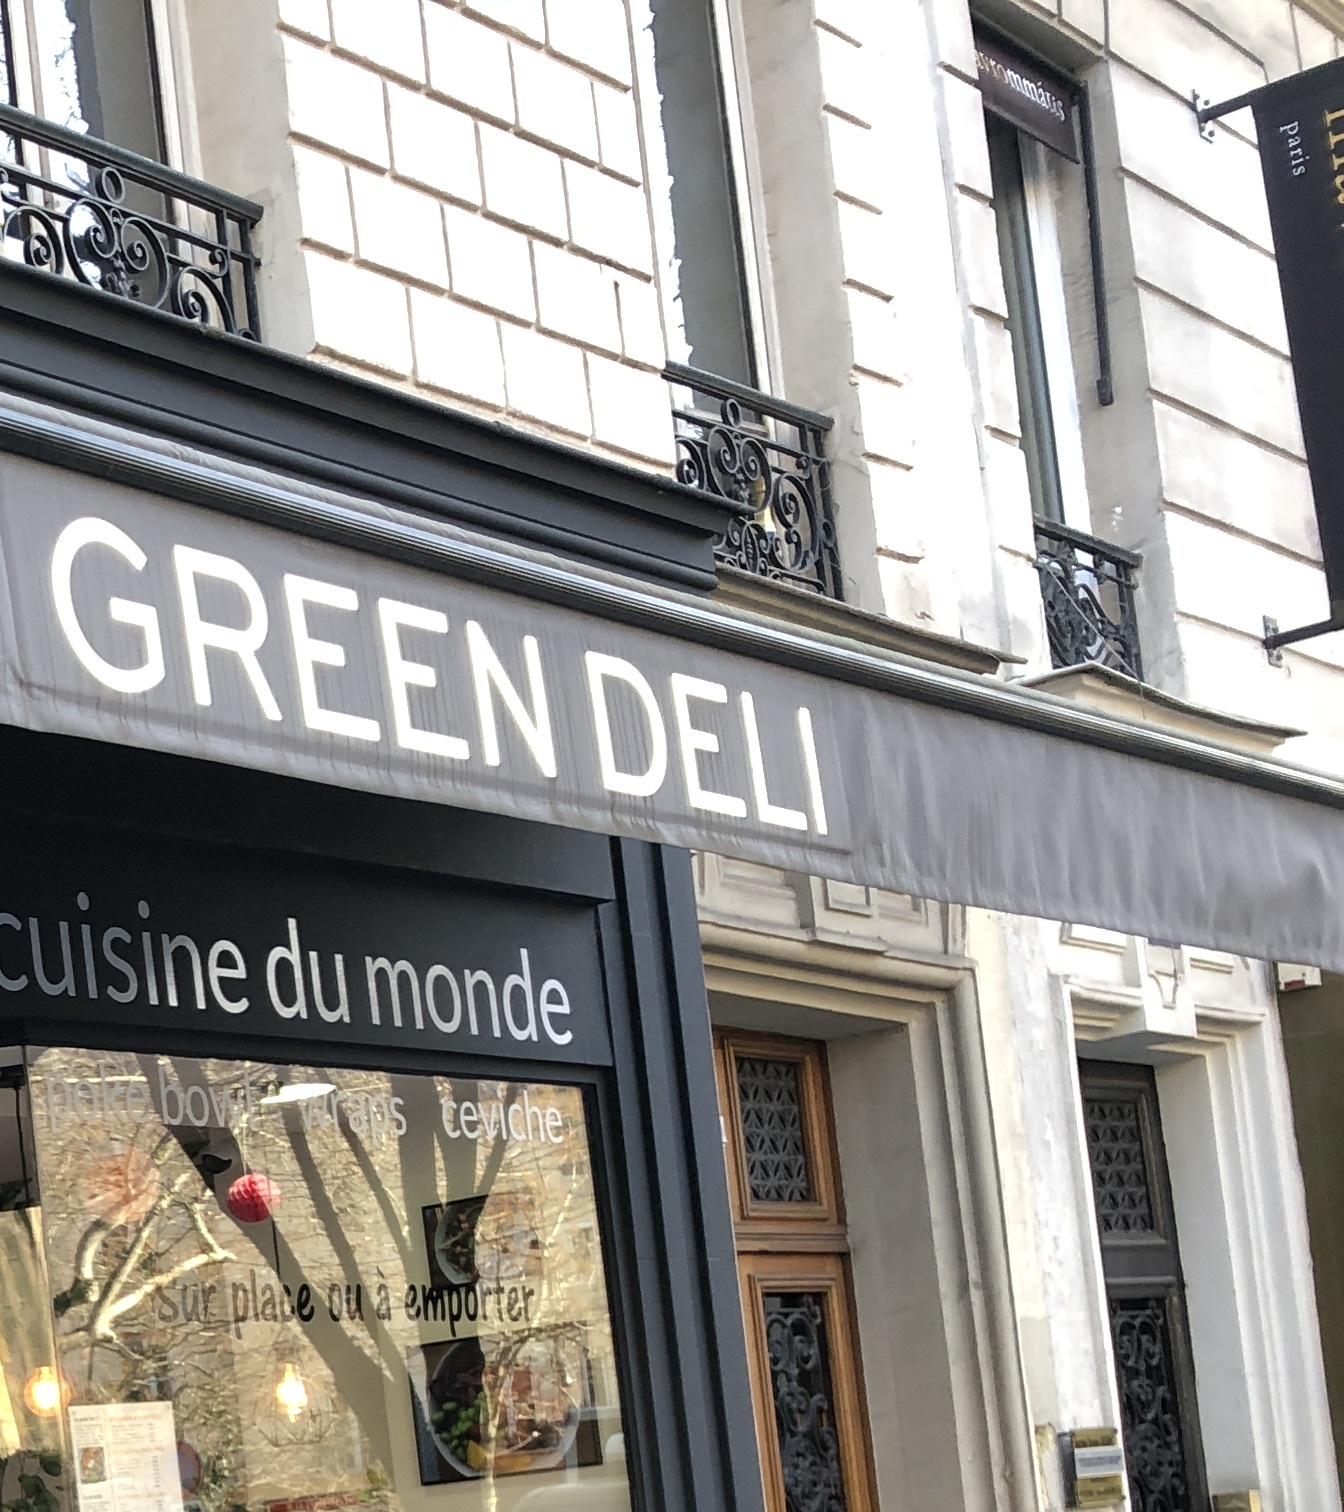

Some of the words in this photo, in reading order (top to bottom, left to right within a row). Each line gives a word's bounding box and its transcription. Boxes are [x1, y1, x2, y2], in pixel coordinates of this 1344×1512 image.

[1278, 121, 1311, 177] paris
[50, 516, 558, 778] GREEN
[584, 650, 829, 835] DELI
[266, 916, 352, 1024] du
[365, 947, 575, 1046] monde
[157, 1064, 257, 1131] bowl
[298, 1088, 408, 1149] wraps
[441, 1087, 565, 1144] ceviche
[230, 1268, 314, 1340] place
[328, 1282, 363, 1323] ou
[376, 1265, 393, 1321] à
[405, 1277, 536, 1337] emporter
